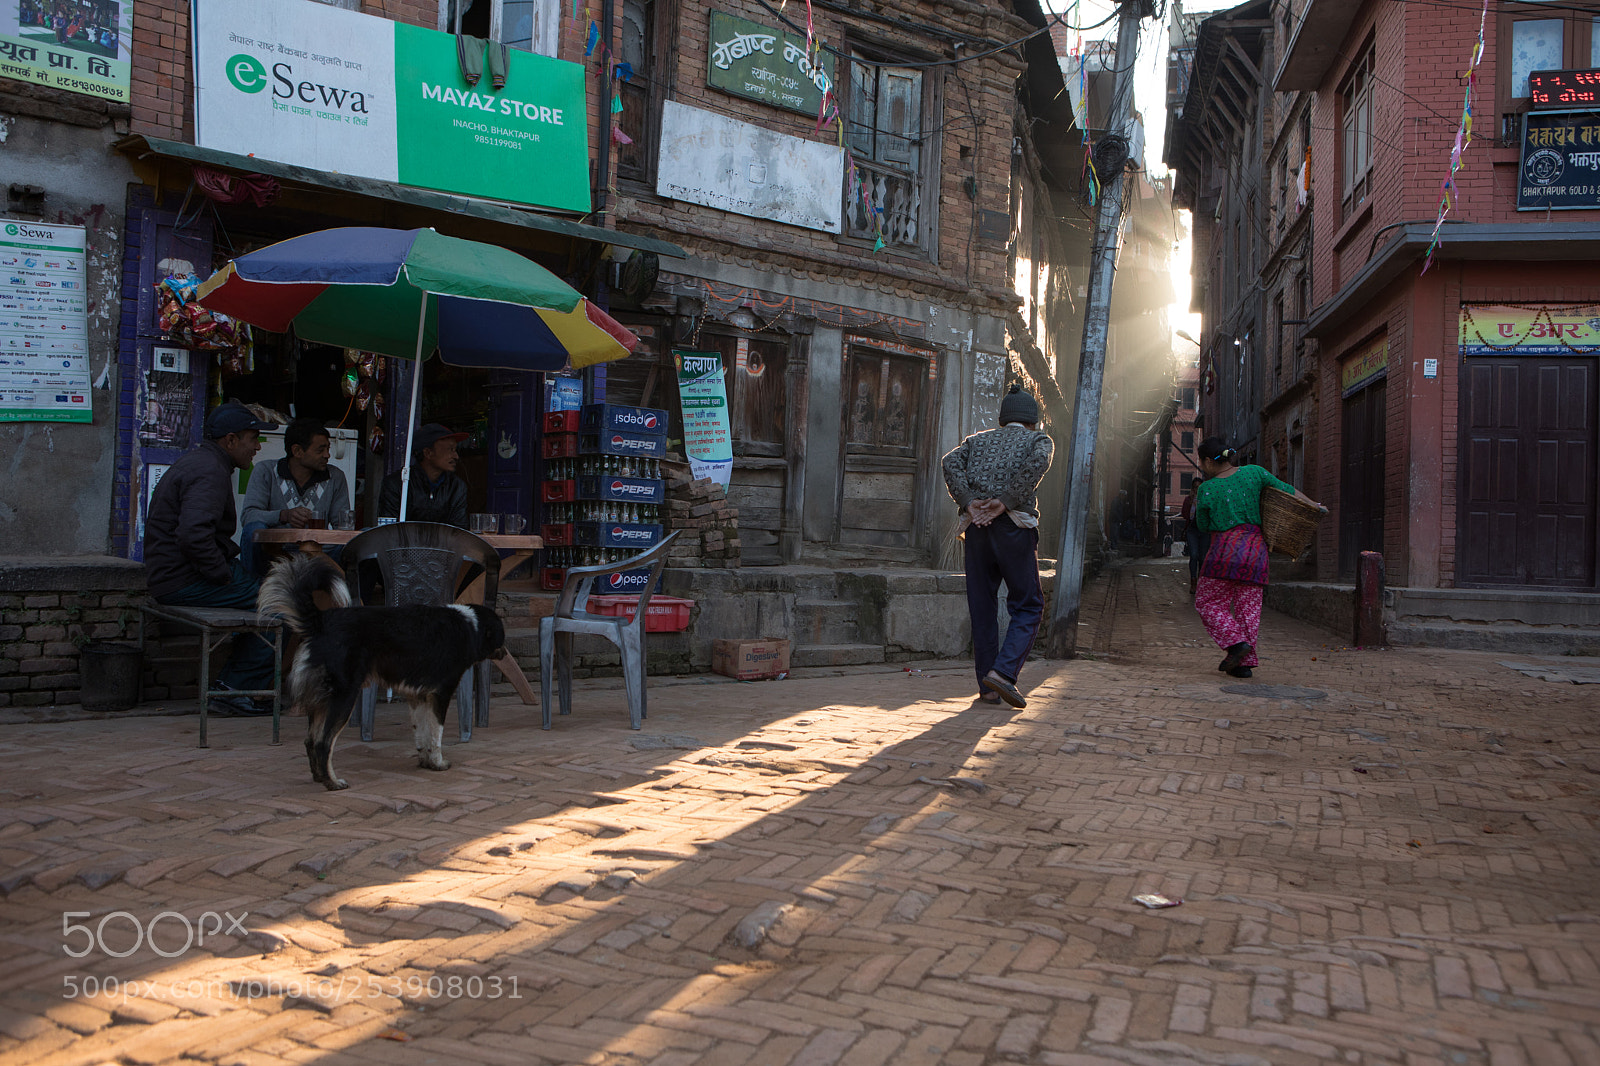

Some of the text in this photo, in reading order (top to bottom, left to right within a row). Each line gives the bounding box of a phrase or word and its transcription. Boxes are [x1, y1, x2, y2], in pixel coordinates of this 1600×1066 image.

[229, 32, 254, 47] नेपाल
[311, 53, 342, 67] अनुमति
[421, 82, 564, 126] MAYAZ STORE
[453, 118, 540, 142] INACHO, BHAKTAPUR
[474, 134, 522, 150] 9851199081
[1523, 186, 1567, 197] BHAKTAPUR
[1569, 185, 1588, 195] GOLD
[1496, 322, 1590, 340] ए. आर.
[684, 356, 718, 375] कल्याण
[615, 413, 644, 424] pepsi
[622, 439, 656, 450] PEPSI
[621, 484, 655, 496] PEPSI
[621, 530, 652, 539] PEPSI
[623, 574, 650, 586] peps
